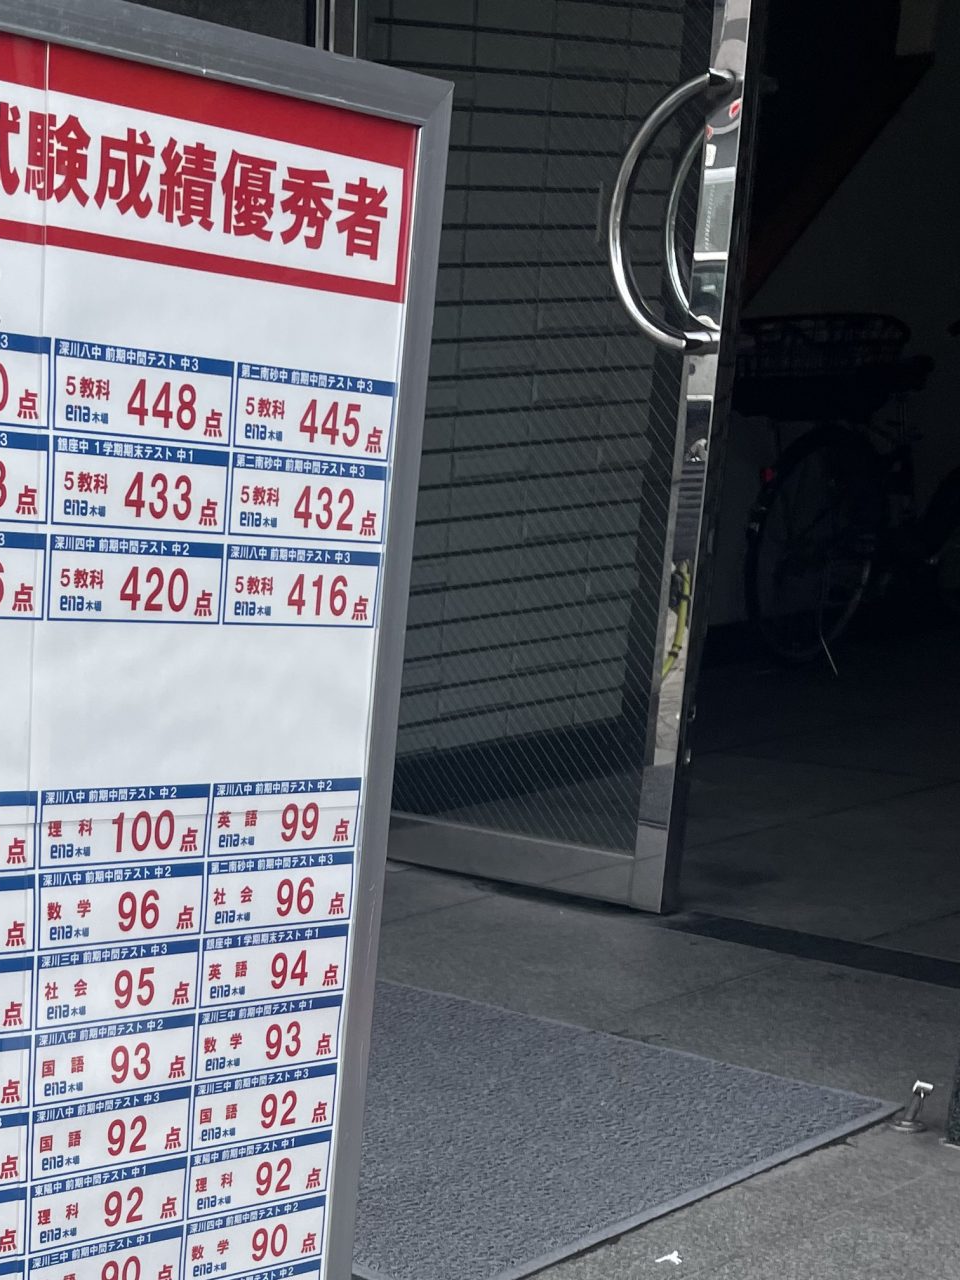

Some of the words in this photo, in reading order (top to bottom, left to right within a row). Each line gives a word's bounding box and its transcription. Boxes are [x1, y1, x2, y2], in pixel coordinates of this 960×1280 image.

[241, 364, 288, 383] 第二南砂中
[291, 371, 352, 390] 前期中間テスト
[357, 380, 373, 392] 中3
[57, 437, 89, 453] 銀座中
[95, 442, 172, 460] 1学期期末テスト
[177, 448, 193, 462] 中1
[235, 576, 273, 595] 5教科
[279, 1266, 294, 1280] 中2
